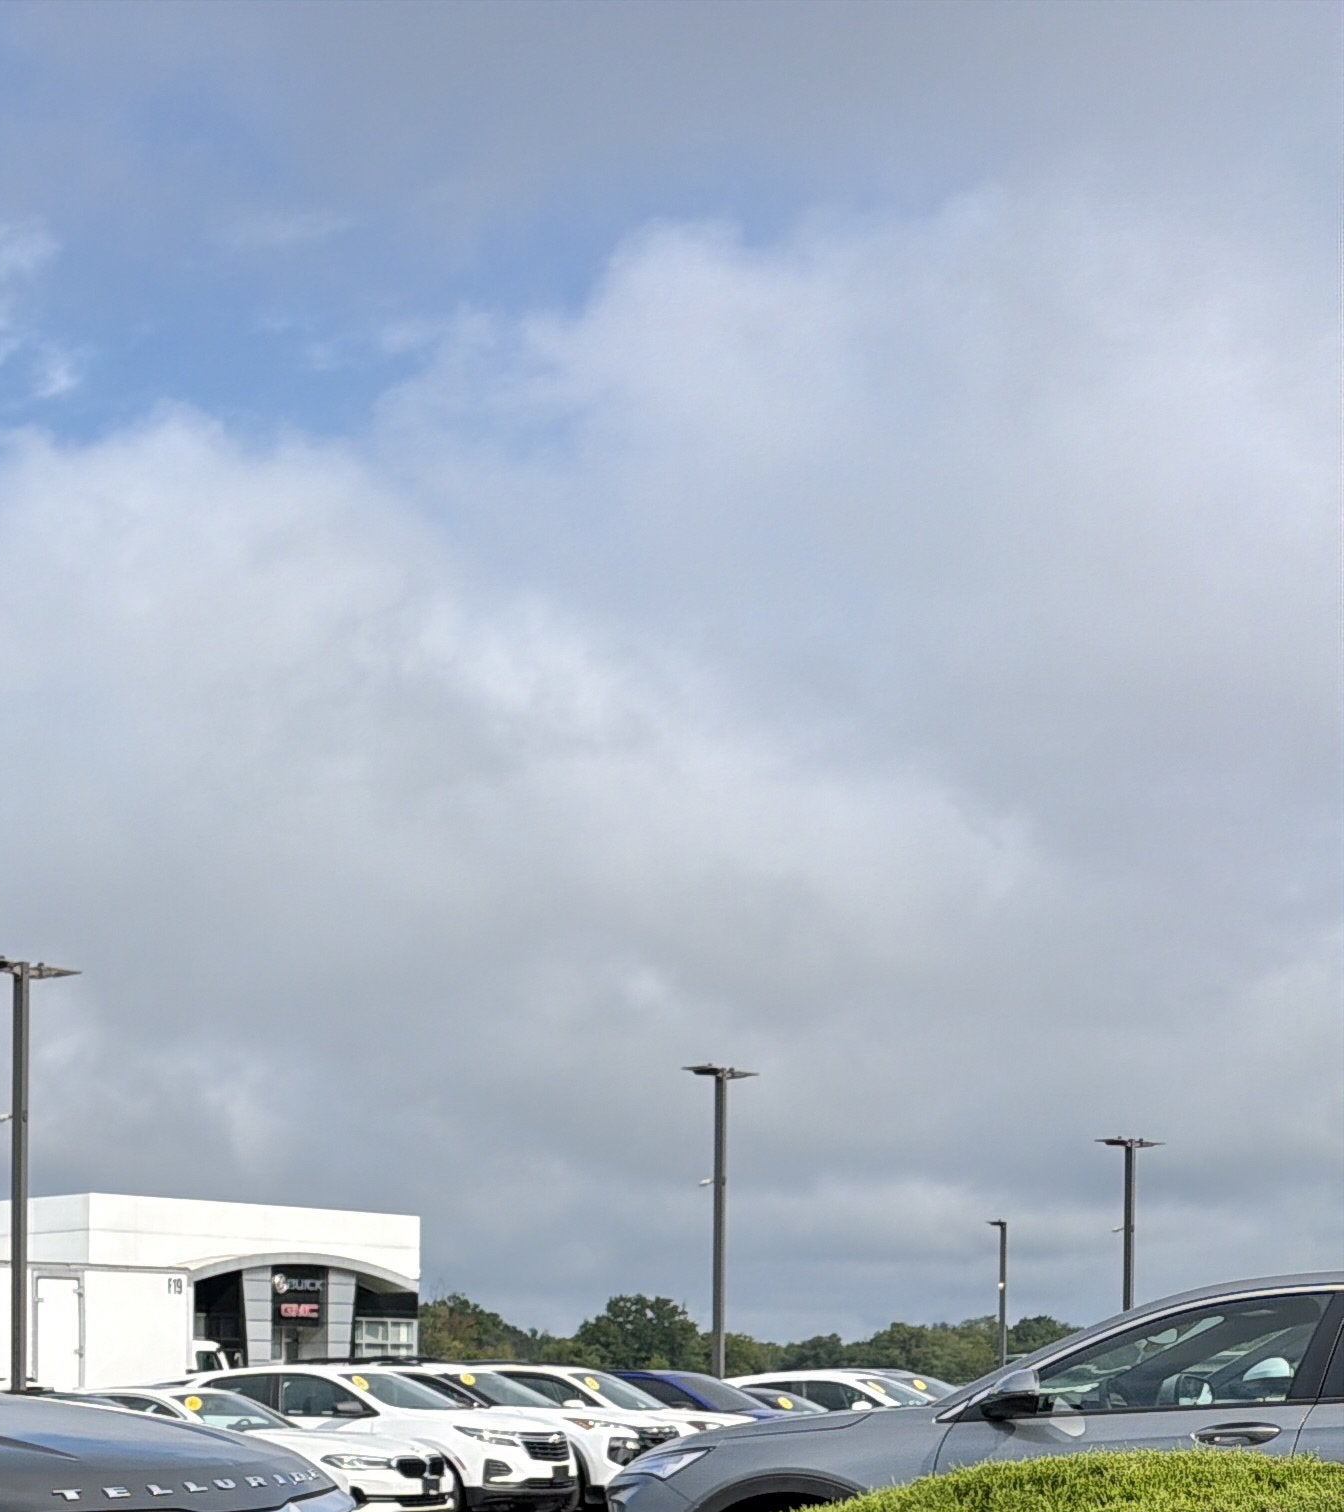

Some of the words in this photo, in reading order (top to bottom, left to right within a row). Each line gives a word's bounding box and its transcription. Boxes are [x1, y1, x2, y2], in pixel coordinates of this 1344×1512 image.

[168, 1278, 183, 1294] F19
[286, 1278, 324, 1291] BUICK
[280, 1303, 319, 1318] GMC
[51, 1469, 320, 1501] TELLURIDE
